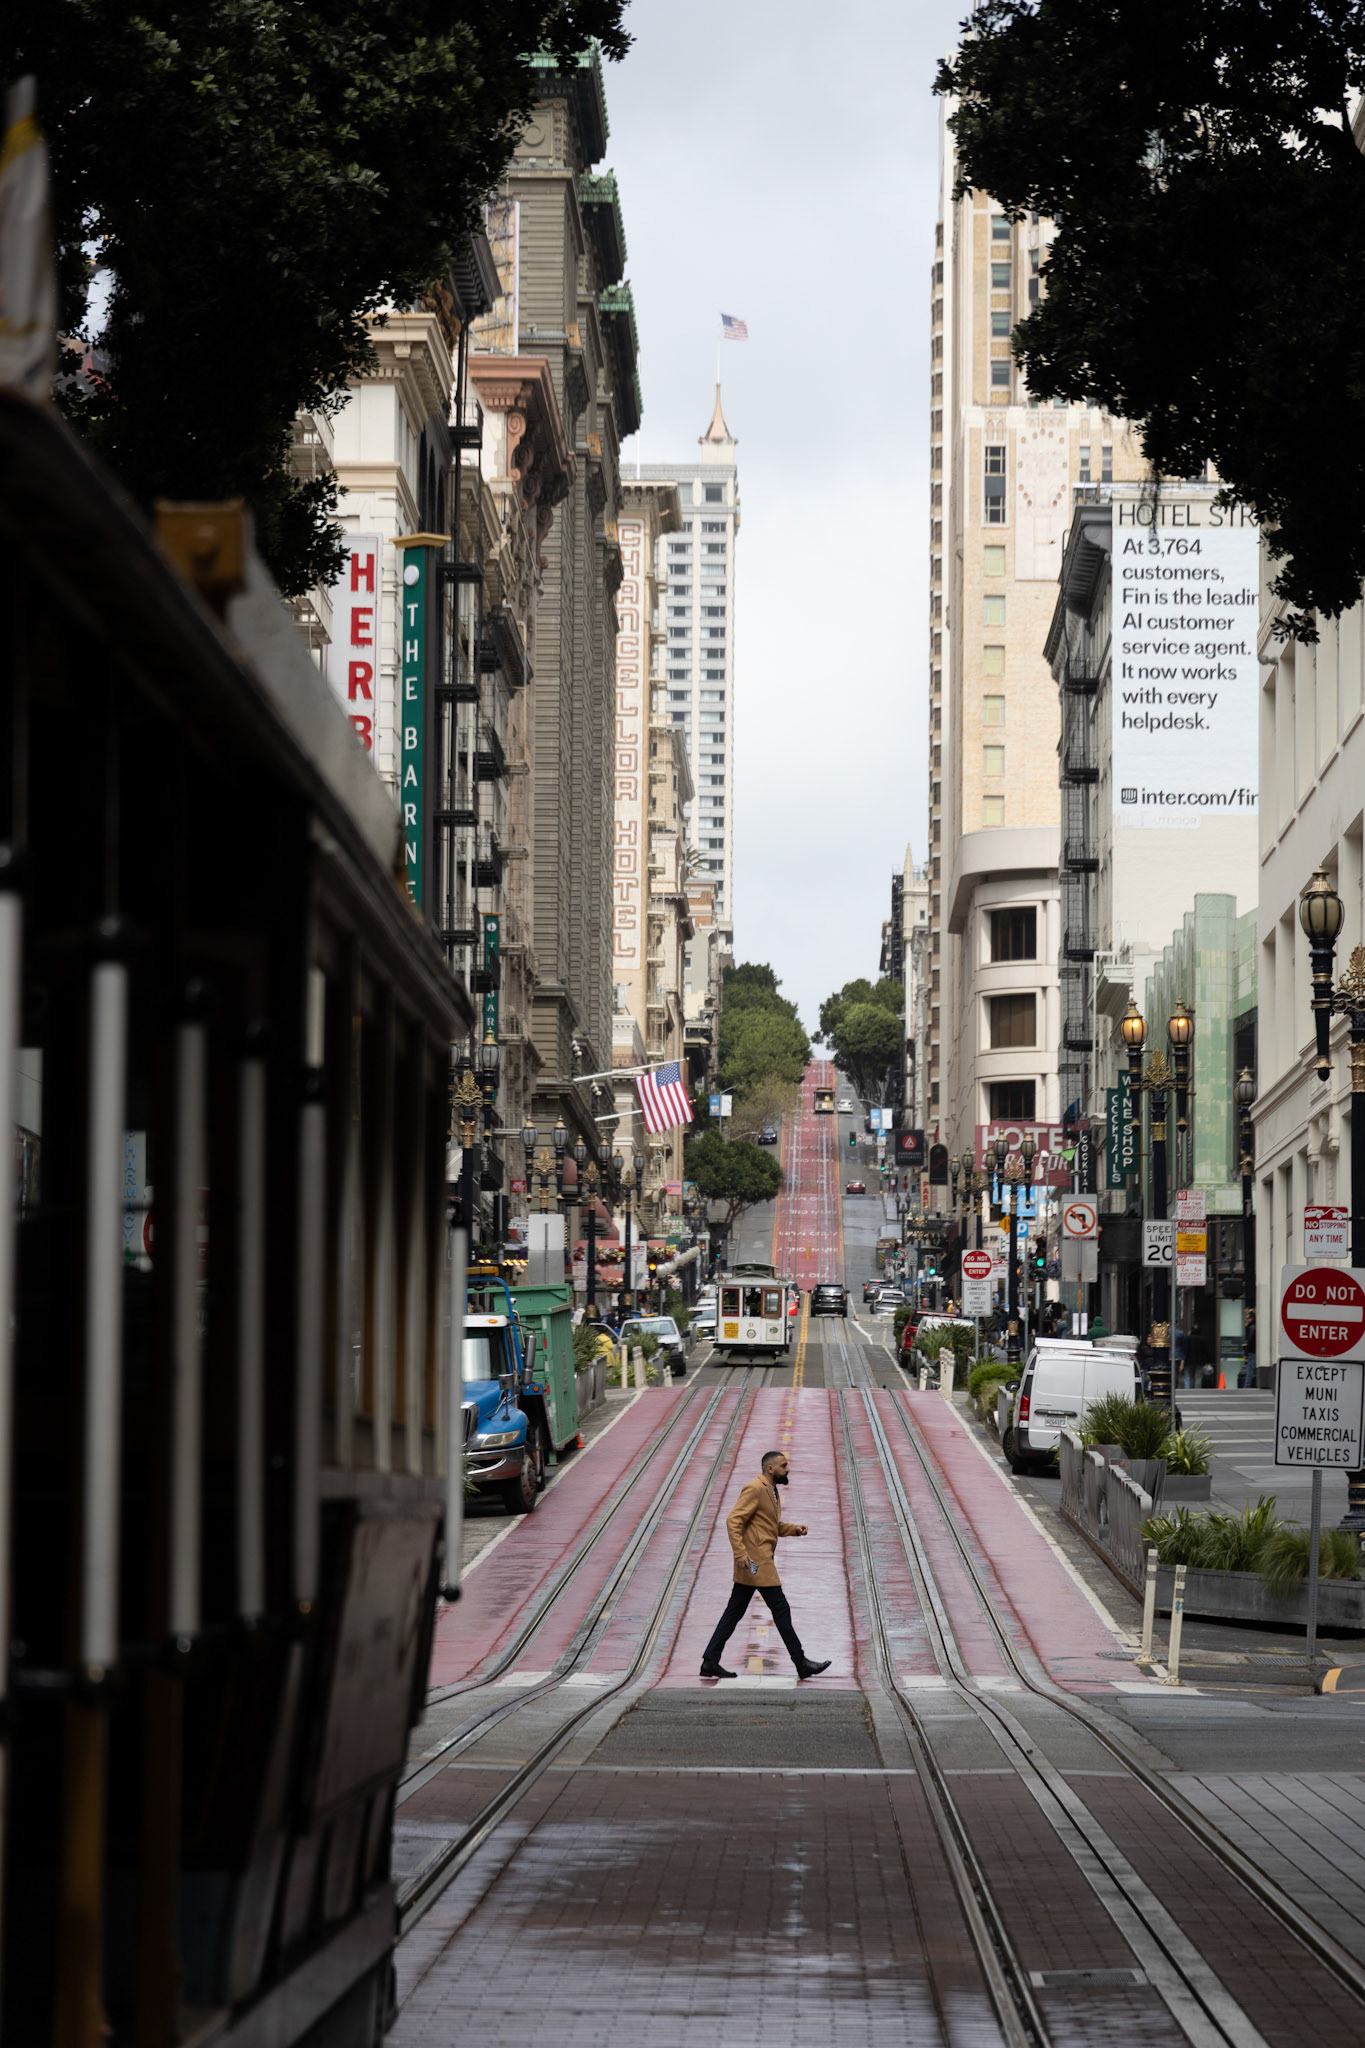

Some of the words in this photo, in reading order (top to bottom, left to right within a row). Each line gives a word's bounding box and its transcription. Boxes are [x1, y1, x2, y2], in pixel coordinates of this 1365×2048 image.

[1119, 504, 1200, 526] HOTEL
[1122, 538, 1144, 555] At
[1148, 538, 1202, 558] 3,764
[1122, 564, 1224, 584] customers,
[1122, 588, 1150, 604] Fin
[1154, 588, 1168, 605] is
[1172, 588, 1202, 606] the
[1122, 612, 1142, 630] AI
[1146, 614, 1235, 630] customer
[405, 603, 418, 700] THE
[1122, 637, 1190, 655] service
[1194, 641, 1252, 660] agent.
[1122, 662, 1134, 679] It
[1138, 666, 1178, 680] now
[1181, 662, 1237, 680] works
[1122, 686, 1162, 704] with
[1166, 692, 1218, 709] every
[1122, 711, 1210, 734] helpdesk.
[1122, 1124, 1134, 1168] SHOP
[1178, 1192, 1186, 1200] NO
[1309, 1234, 1324, 1243] ANY
[1326, 1234, 1343, 1243] TIME
[1295, 1284, 1316, 1299] DO
[1326, 1286, 1357, 1300] NOT
[1299, 1325, 1348, 1340] ENTER
[1297, 1366, 1347, 1382] EXCEPT
[1306, 1387, 1337, 1401] MUNI
[1302, 1407, 1340, 1421] TAXIS
[1281, 1426, 1357, 1442] COMMERCIAL
[1288, 1446, 1350, 1462] VEHICLES
